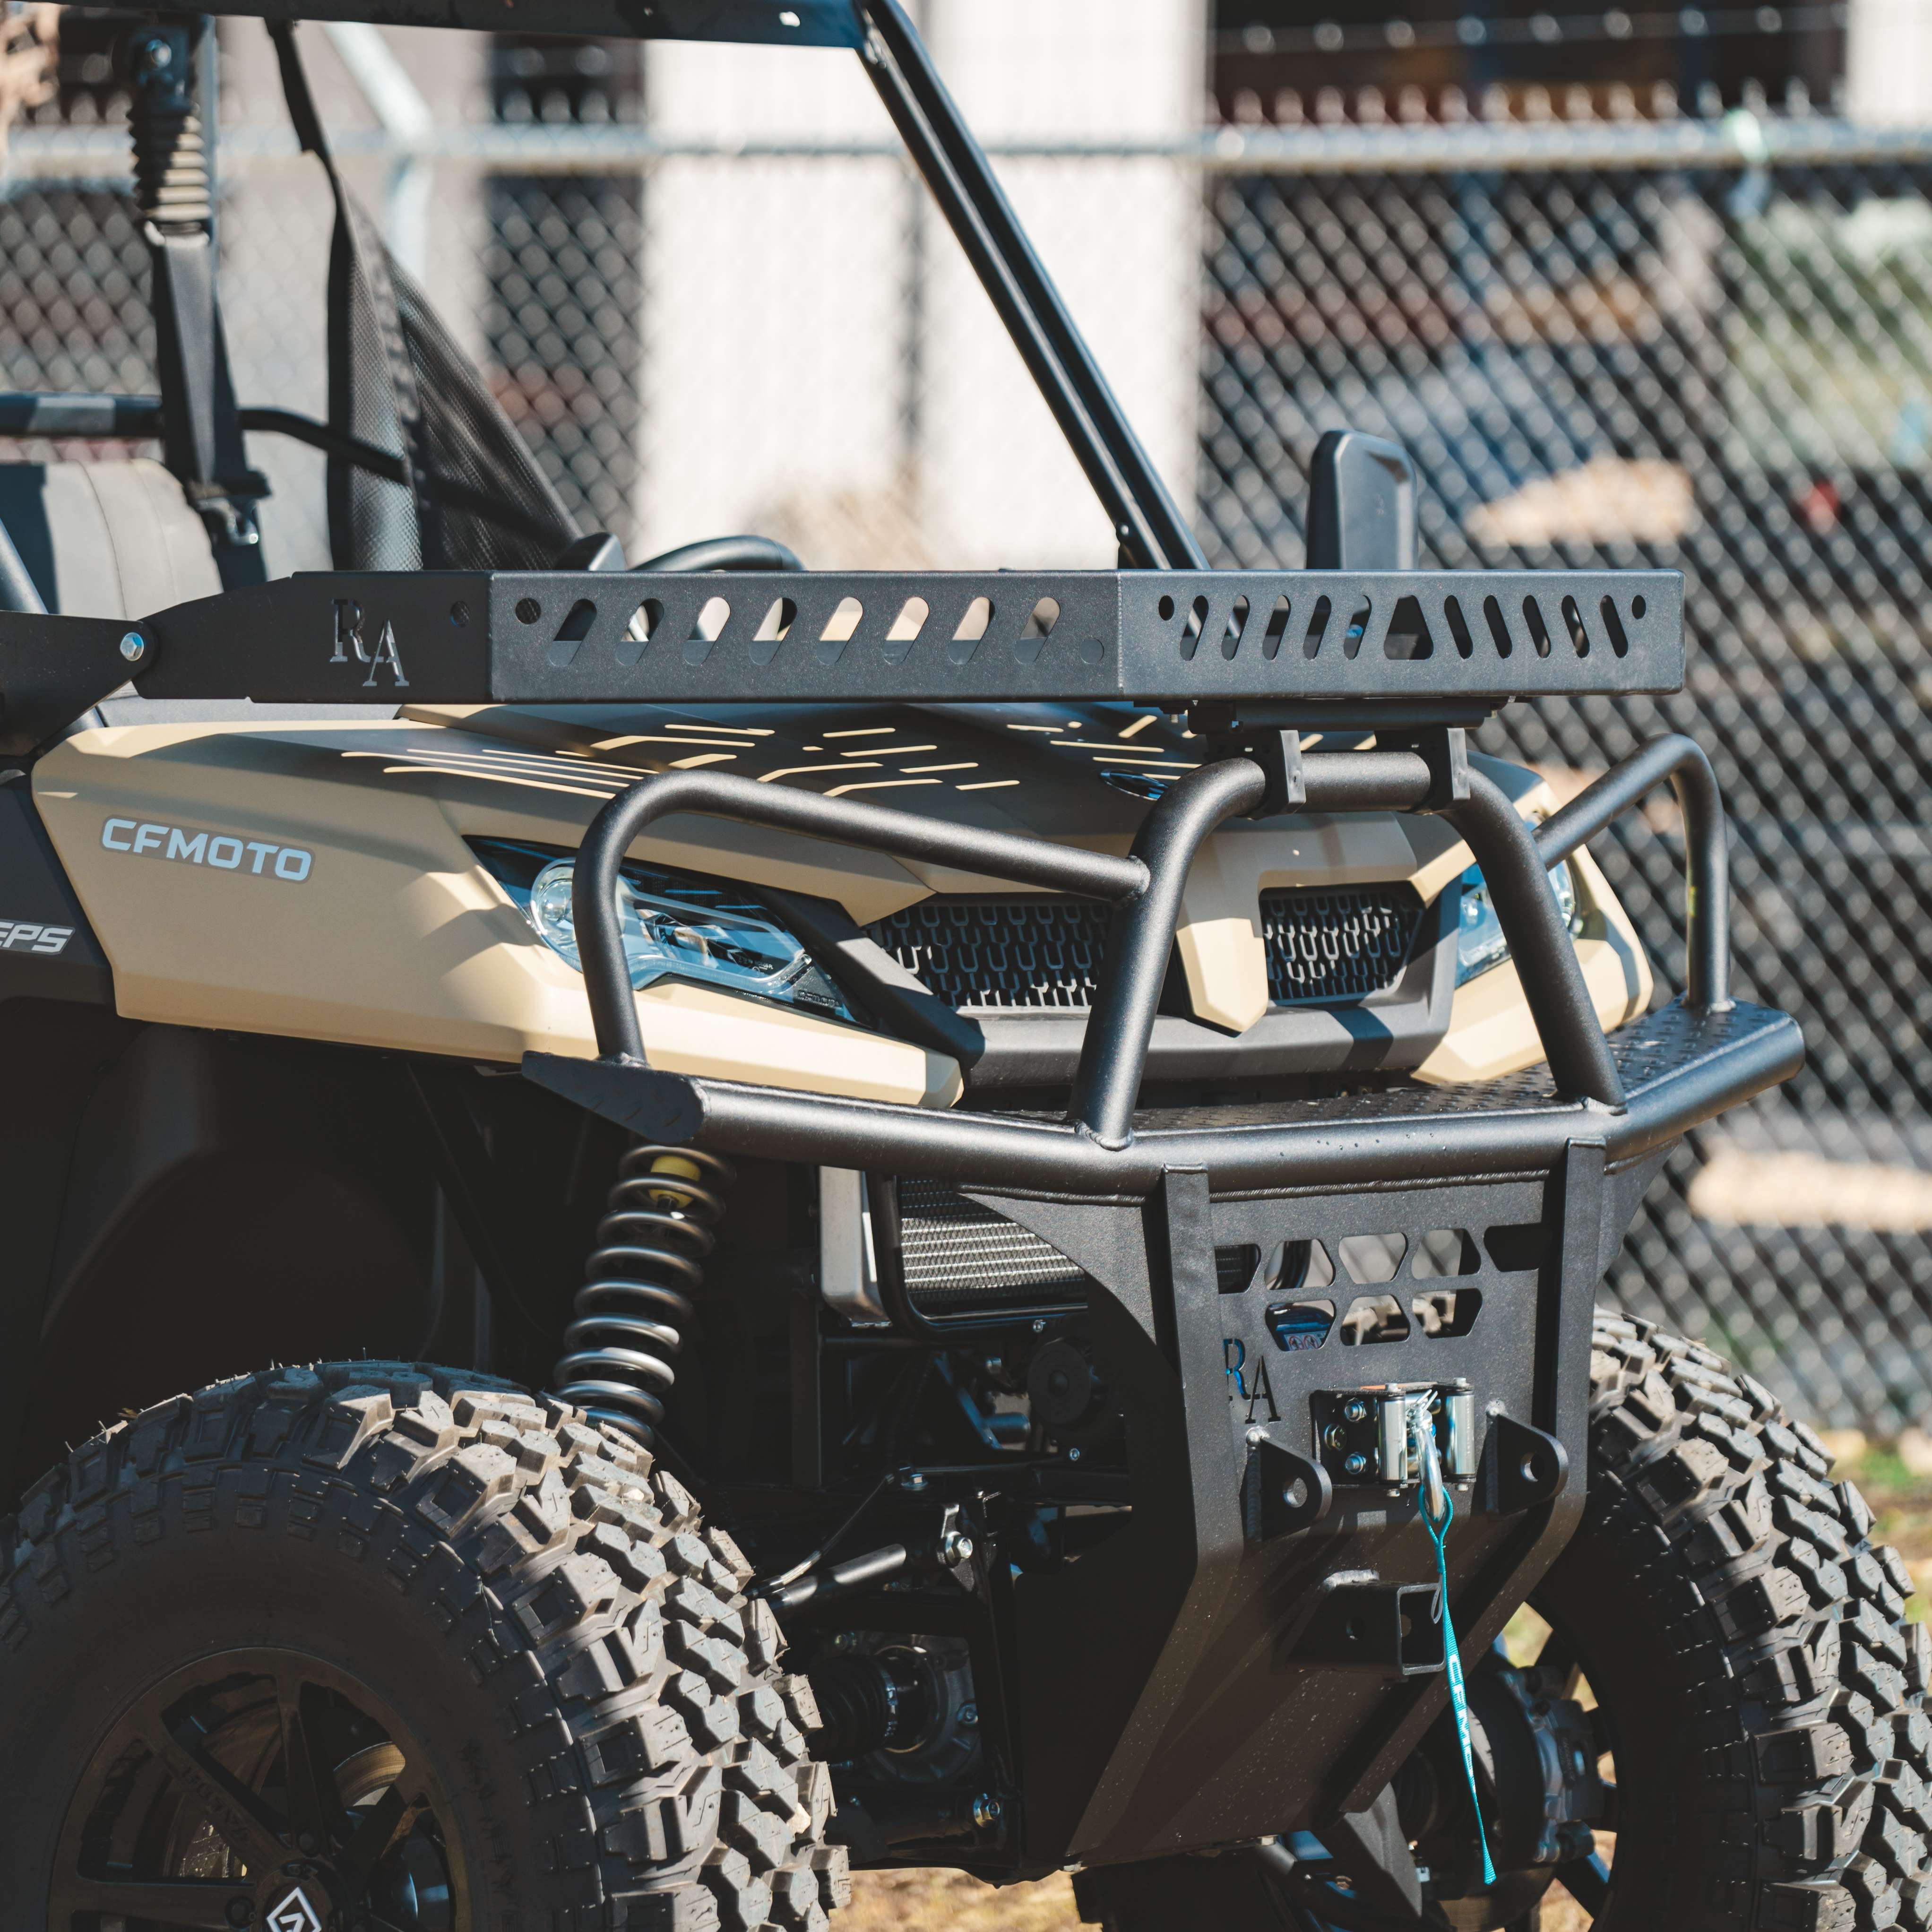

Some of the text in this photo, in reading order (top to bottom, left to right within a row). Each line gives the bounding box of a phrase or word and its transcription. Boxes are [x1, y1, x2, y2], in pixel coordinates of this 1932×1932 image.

[329, 599, 410, 687] RA
[102, 818, 312, 881] CFMOTO
[1223, 1338, 1281, 1424] RA
